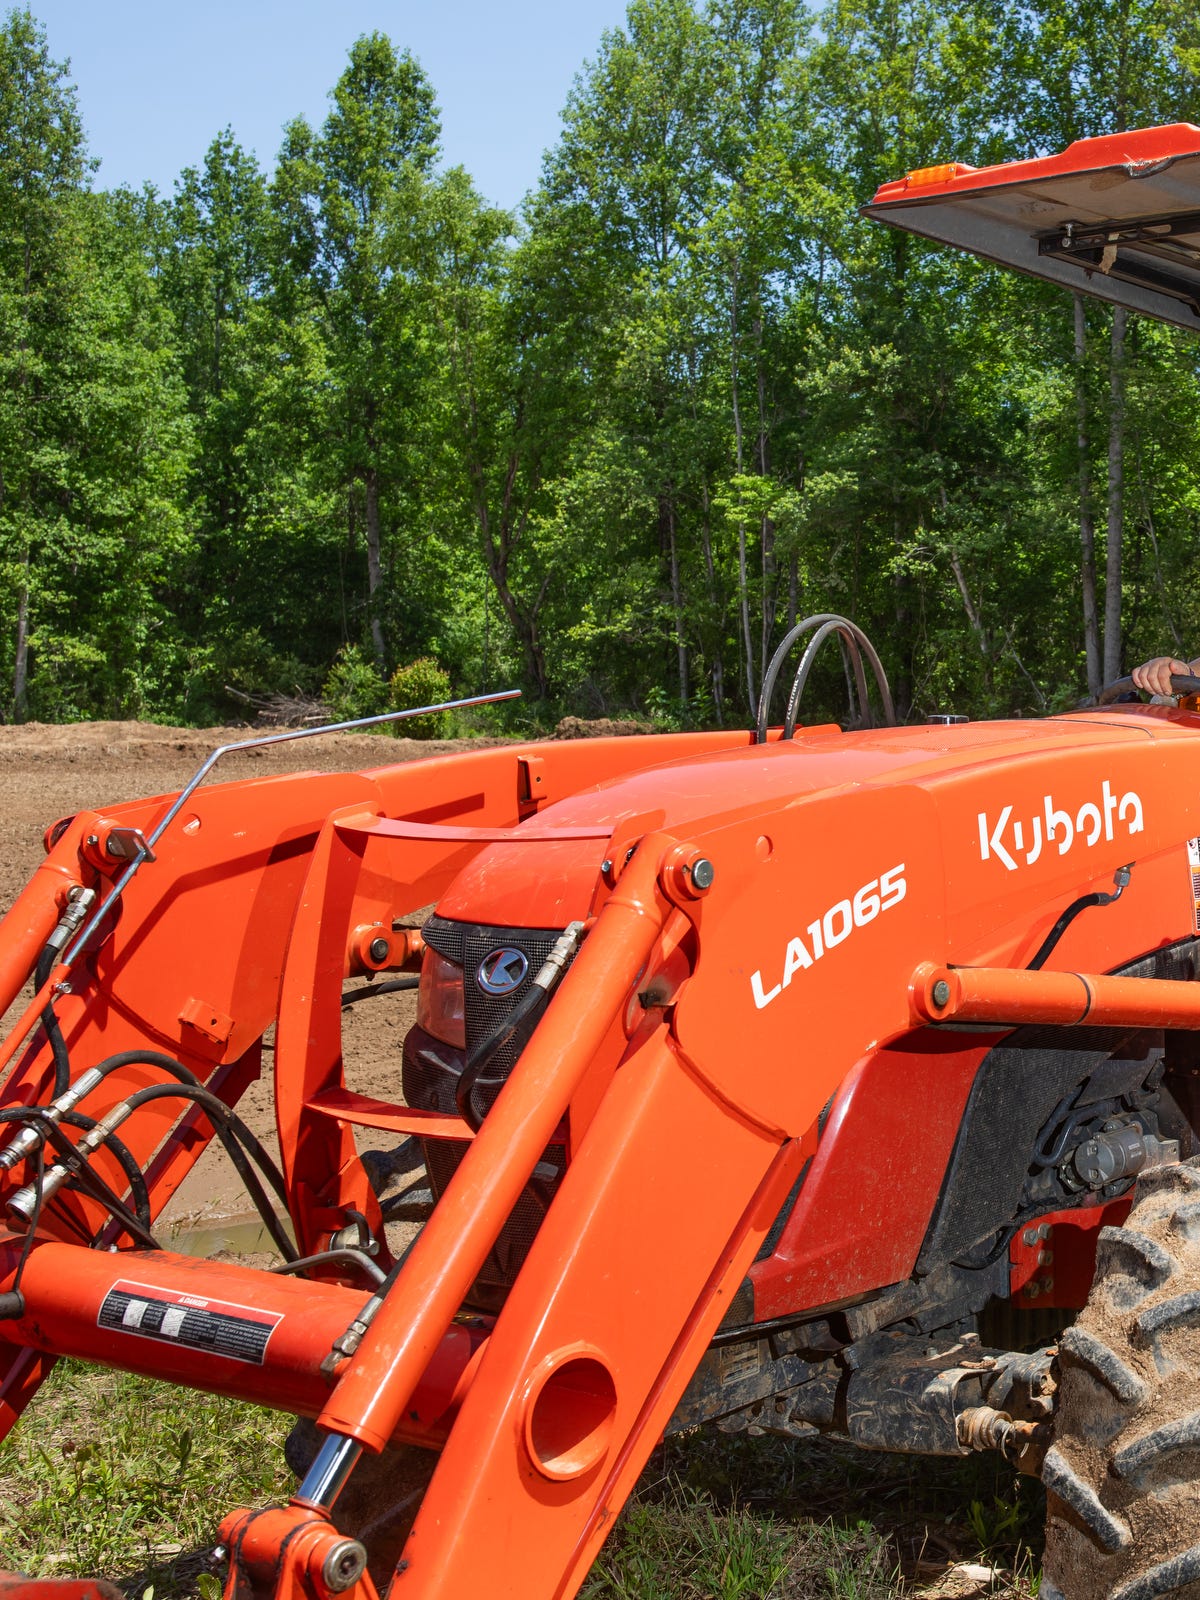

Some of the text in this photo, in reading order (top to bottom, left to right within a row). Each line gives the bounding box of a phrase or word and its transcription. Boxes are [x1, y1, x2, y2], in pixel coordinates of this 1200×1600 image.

[977, 780, 1144, 871] Kubota
[750, 863, 907, 1009] LA1065
[184, 1297, 209, 1308] DANGER
